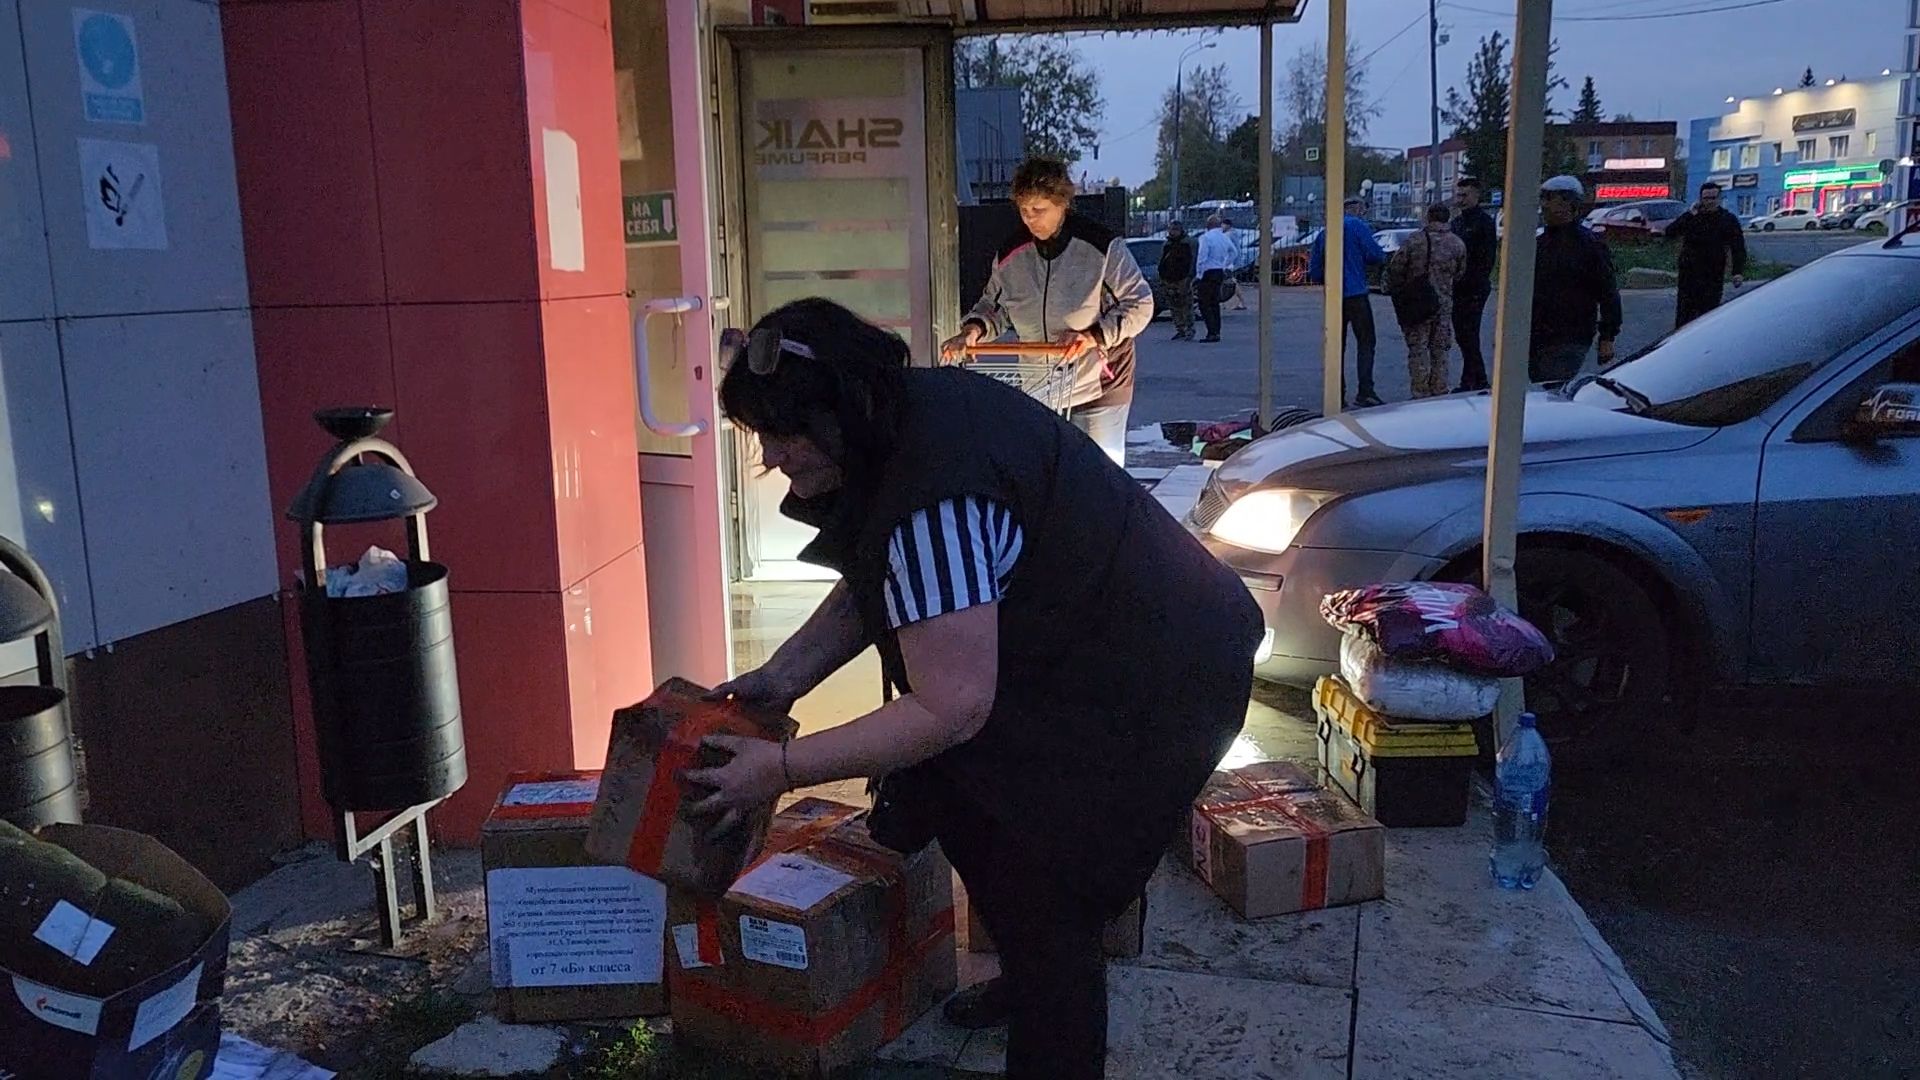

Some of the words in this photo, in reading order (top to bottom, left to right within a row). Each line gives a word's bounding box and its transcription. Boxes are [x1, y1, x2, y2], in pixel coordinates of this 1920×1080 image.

[632, 202, 651, 217] НА
[626, 219, 660, 236] СЕБЯ
[531, 965, 546, 976] от
[550, 963, 556, 975] 7
[561, 962, 585, 974] «Б»
[588, 963, 632, 974] класса
